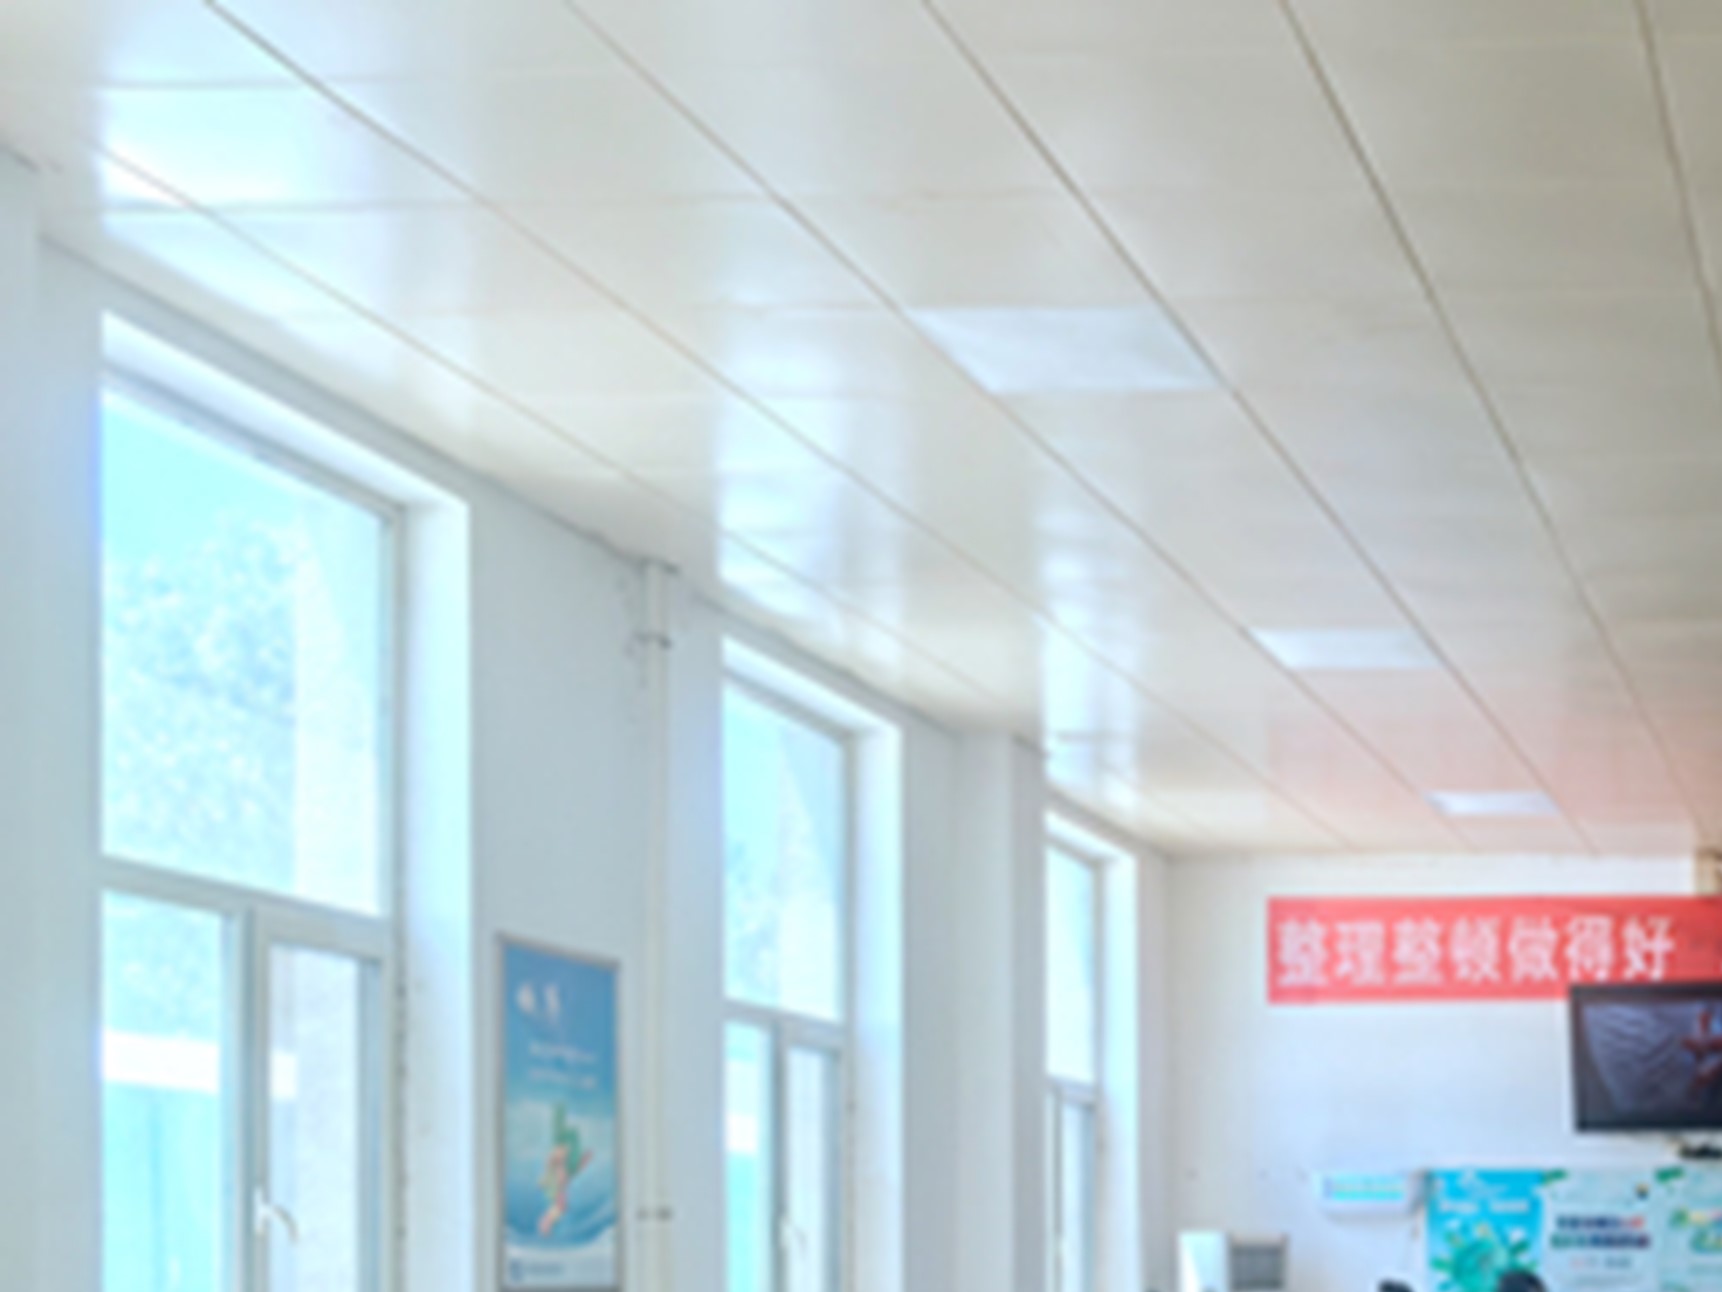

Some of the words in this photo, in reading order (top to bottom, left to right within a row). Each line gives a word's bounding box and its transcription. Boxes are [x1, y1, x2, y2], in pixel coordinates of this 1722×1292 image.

[1276, 913, 1676, 987] 整理整顿做得好
